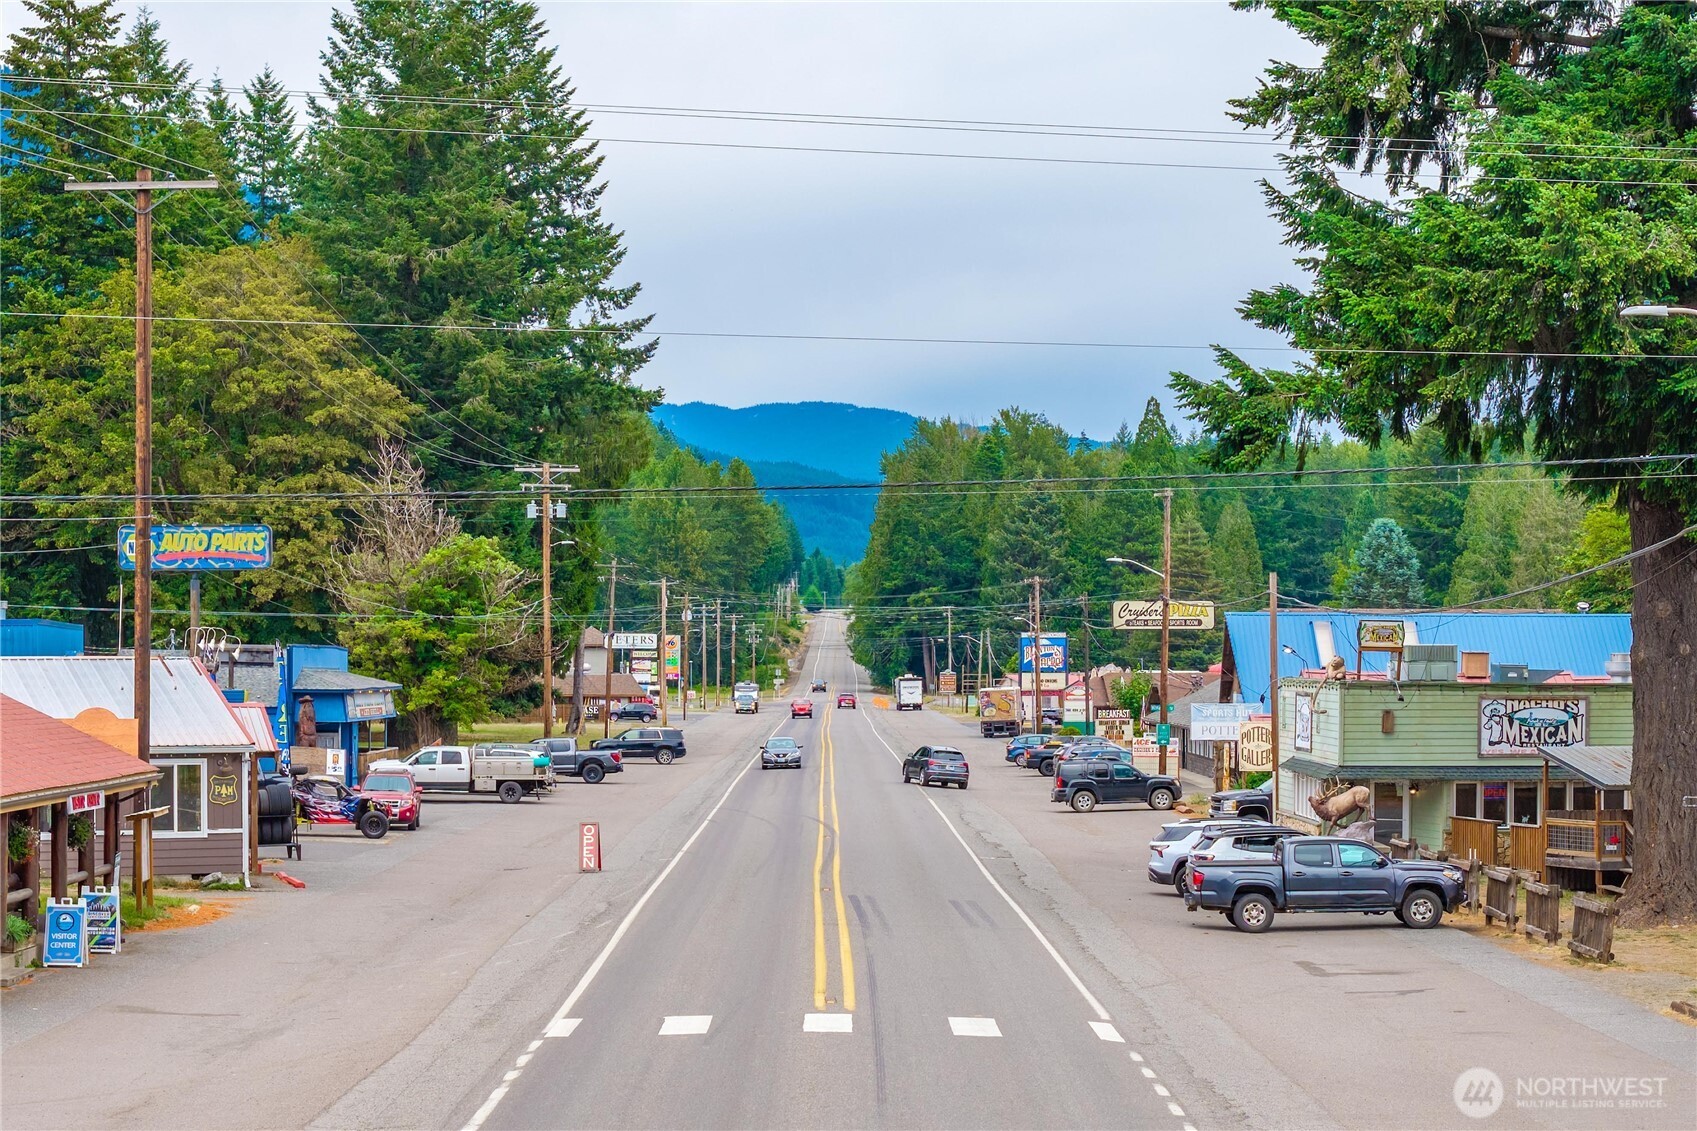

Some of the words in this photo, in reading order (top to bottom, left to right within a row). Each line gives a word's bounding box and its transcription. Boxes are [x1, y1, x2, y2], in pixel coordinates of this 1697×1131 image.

[159, 532, 208, 552] AUTO
[211, 532, 266, 552] PARTS
[1118, 603, 1163, 618] Cruiser's
[1169, 603, 1209, 616] PIZZA
[615, 635, 654, 645] ETERS
[1098, 710, 1130, 718] BREAKFAST
[1202, 708, 1232, 717] SPORTS
[1236, 708, 1252, 717] HUT
[1506, 699, 1579, 714] NACHO'S
[1201, 726, 1239, 736] POTTE
[1241, 726, 1272, 744] POTTER
[1501, 714, 1584, 747] MEXICAN
[1241, 747, 1272, 766] GALLER
[1484, 788, 1506, 796] OPEN
[583, 824, 595, 868] OPEN
